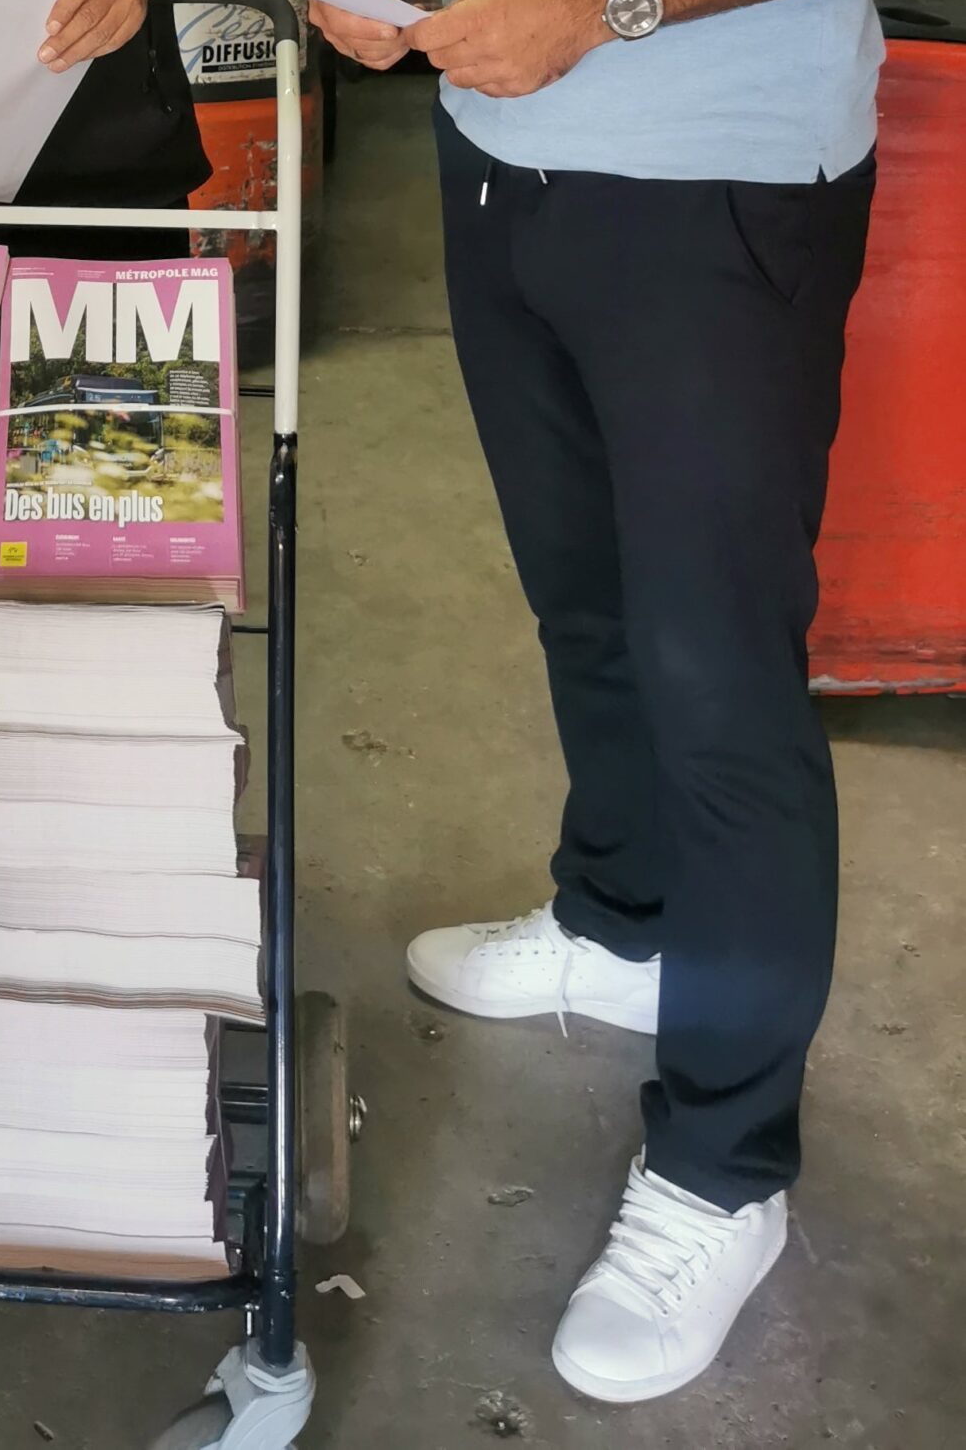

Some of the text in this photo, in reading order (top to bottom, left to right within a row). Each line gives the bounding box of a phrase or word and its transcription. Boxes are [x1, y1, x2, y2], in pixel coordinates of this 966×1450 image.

[202, 40, 276, 63] DIFFUSI
[115, 269, 189, 280] MÉTROPOLE
[190, 268, 218, 278] MAG
[11, 279, 220, 363] MM
[4, 487, 164, 528] Des bus en plus
